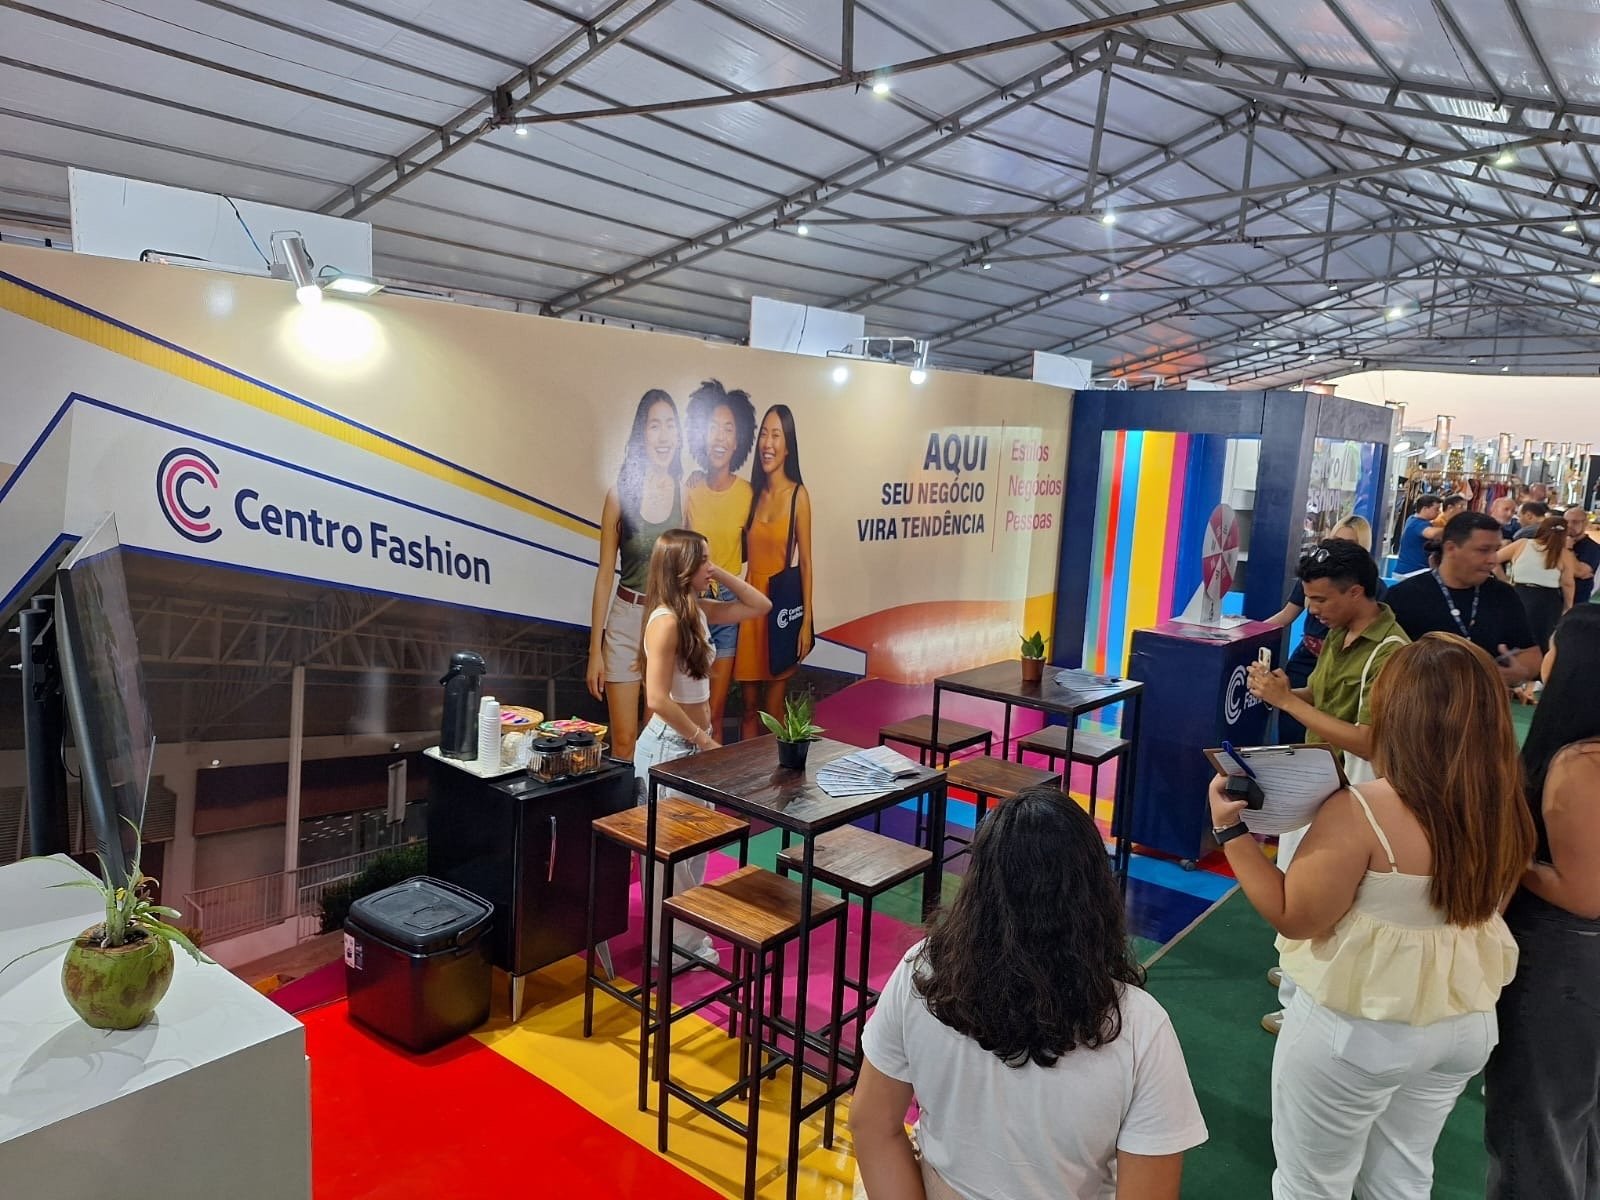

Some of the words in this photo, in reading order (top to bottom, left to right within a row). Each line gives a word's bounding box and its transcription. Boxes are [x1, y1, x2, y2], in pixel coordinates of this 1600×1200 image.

[923, 432, 988, 475] AQUI
[1011, 439, 1049, 461] Estilos
[881, 482, 914, 505] SEU
[917, 477, 985, 504] NEGÓCIO
[1008, 474, 1062, 501] Negócios
[857, 517, 897, 542] VIRA
[901, 510, 985, 539] TENDÊNCIA
[1005, 510, 1053, 532] Pessoas
[234, 488, 363, 553] Centro
[370, 521, 491, 585] Fashion
